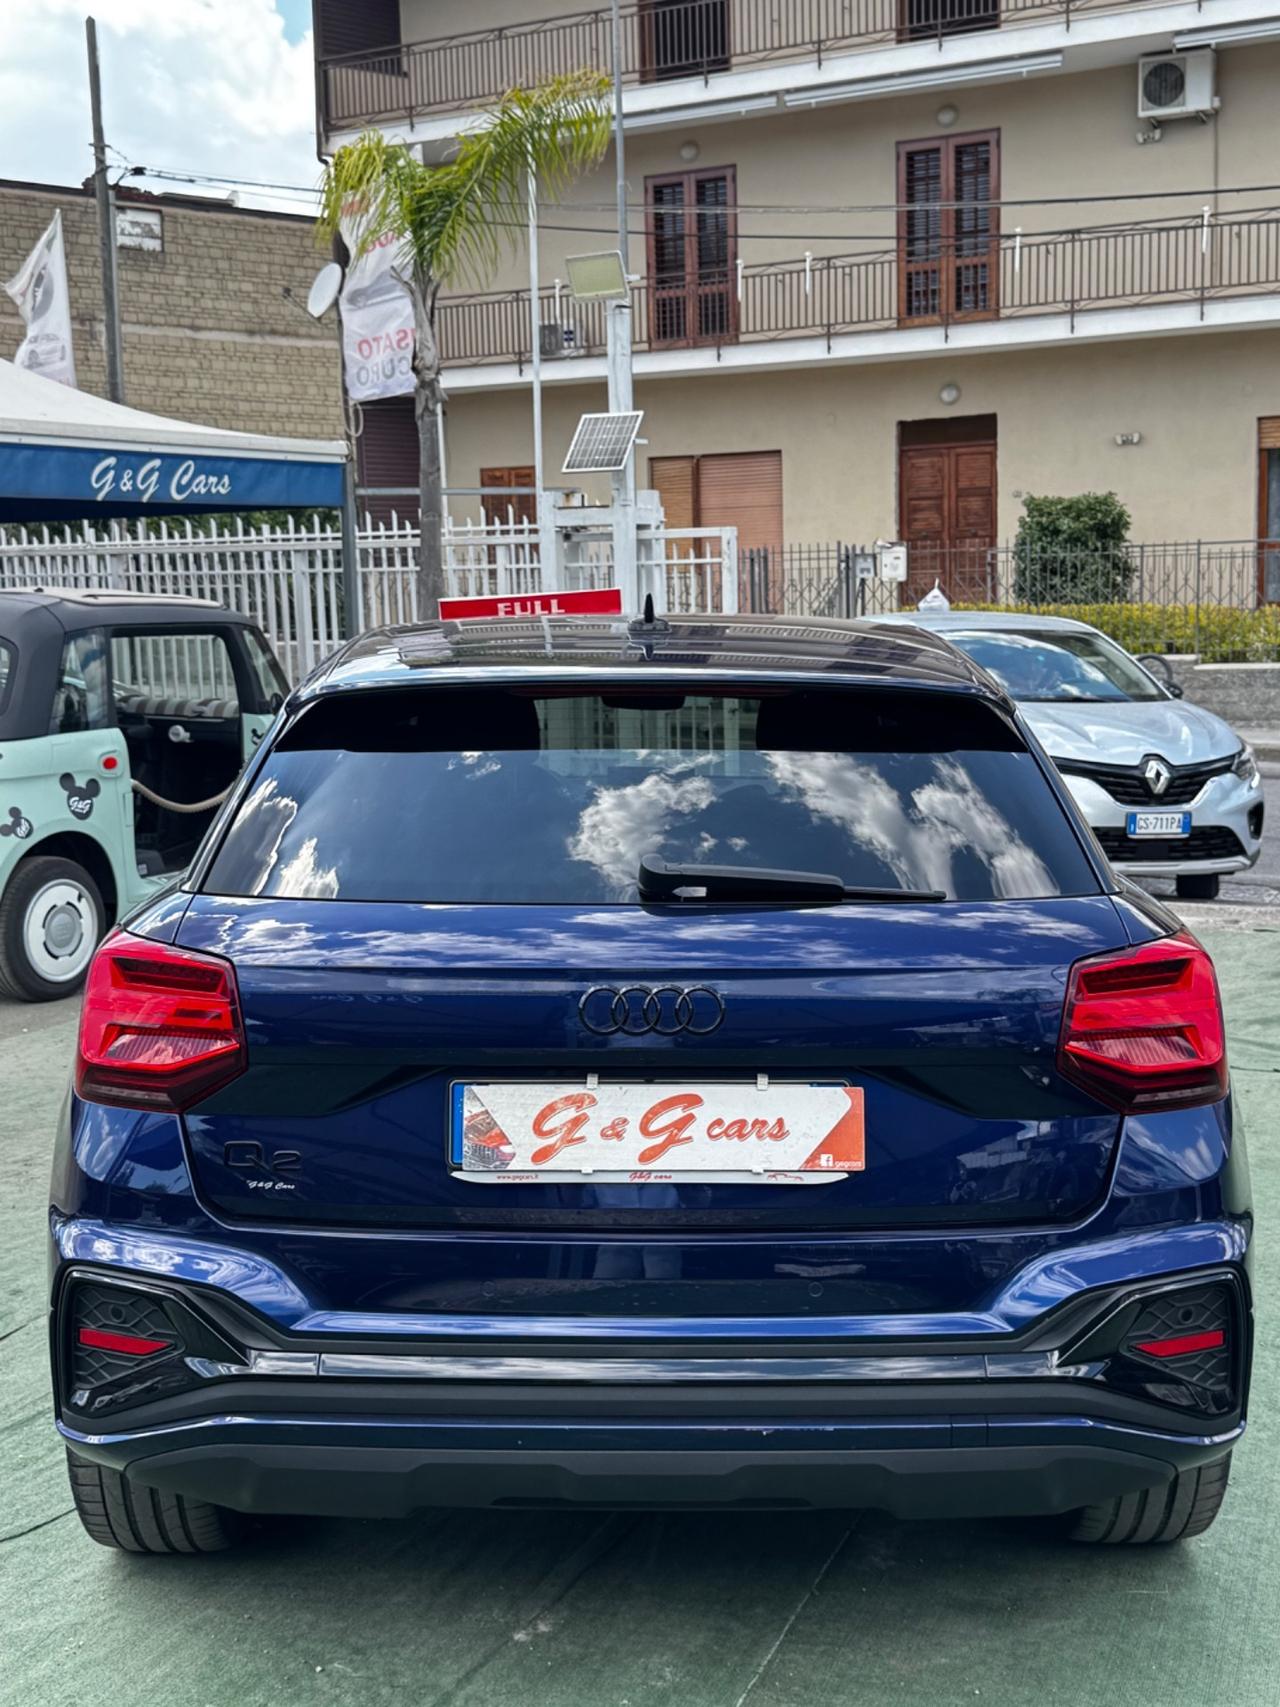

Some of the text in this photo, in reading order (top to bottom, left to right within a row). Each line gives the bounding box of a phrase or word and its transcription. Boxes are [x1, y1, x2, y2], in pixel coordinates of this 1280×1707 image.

[169, 459, 232, 500] Cars
[497, 599, 565, 617] FULL
[705, 1116, 791, 1143] cars
[224, 1140, 302, 1171] Q2
